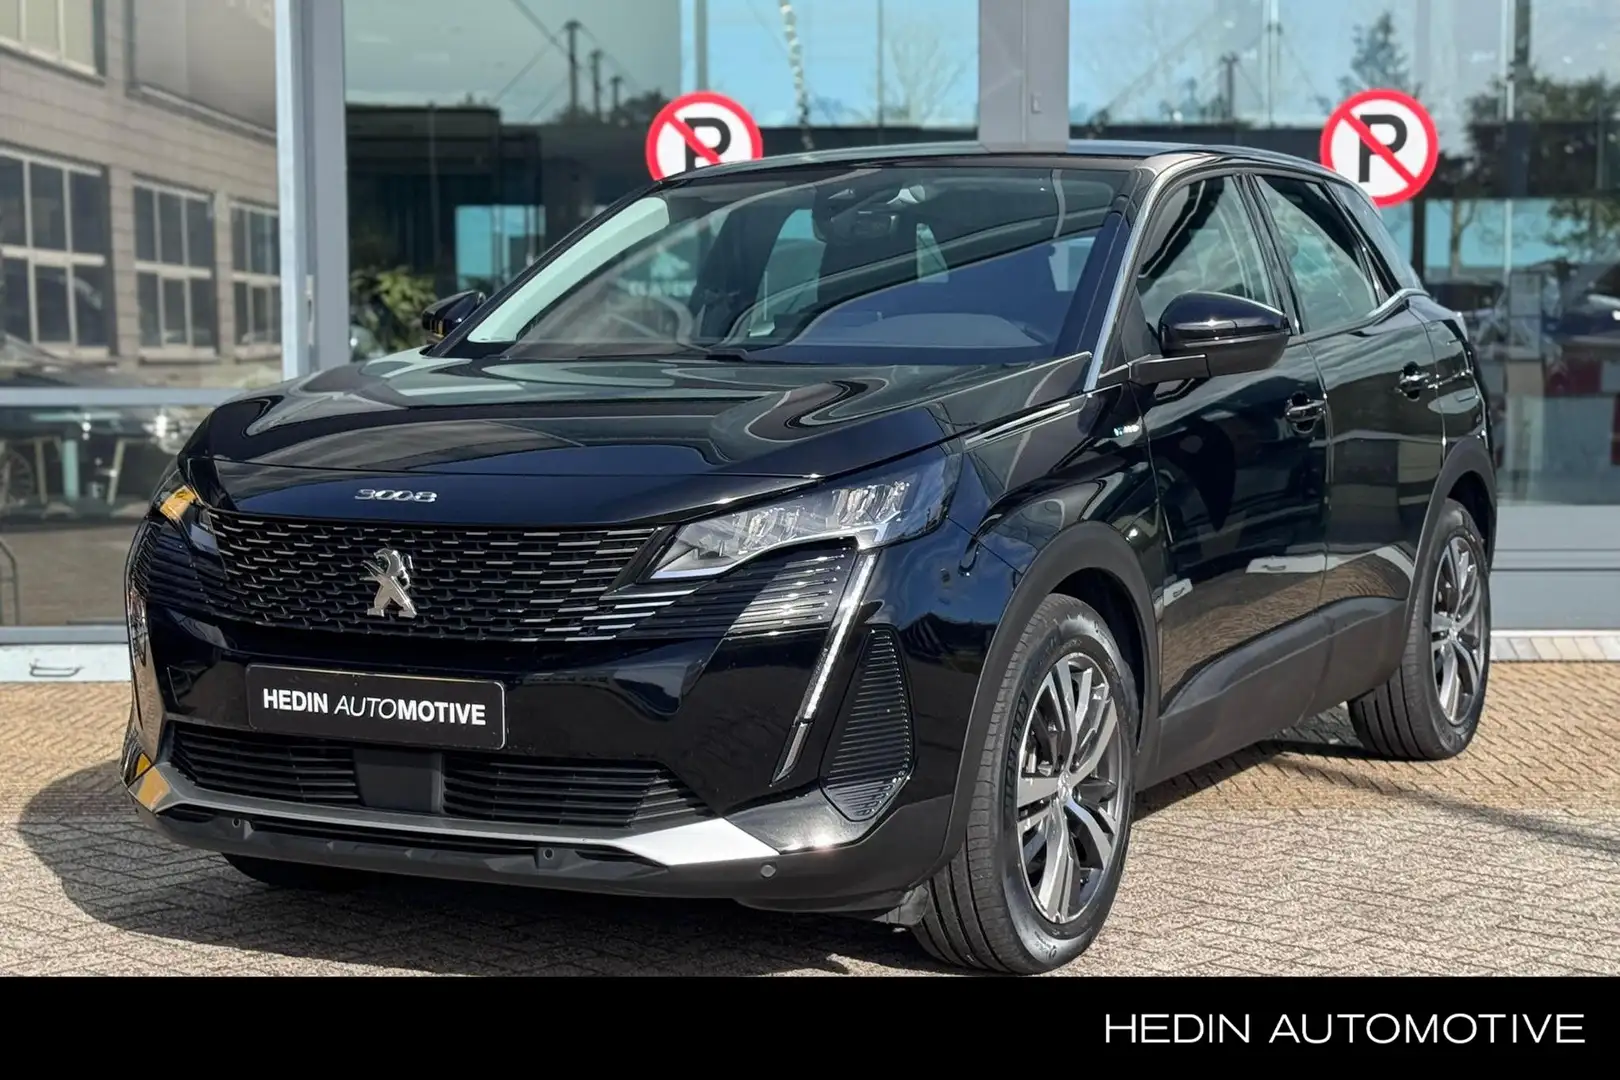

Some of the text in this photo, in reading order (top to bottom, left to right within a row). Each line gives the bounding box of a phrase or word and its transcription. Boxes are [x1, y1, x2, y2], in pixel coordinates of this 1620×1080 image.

[1358, 114, 1408, 183] P
[354, 488, 438, 503] 3008
[262, 687, 487, 726] HEDIN AUTOMOTIVE
